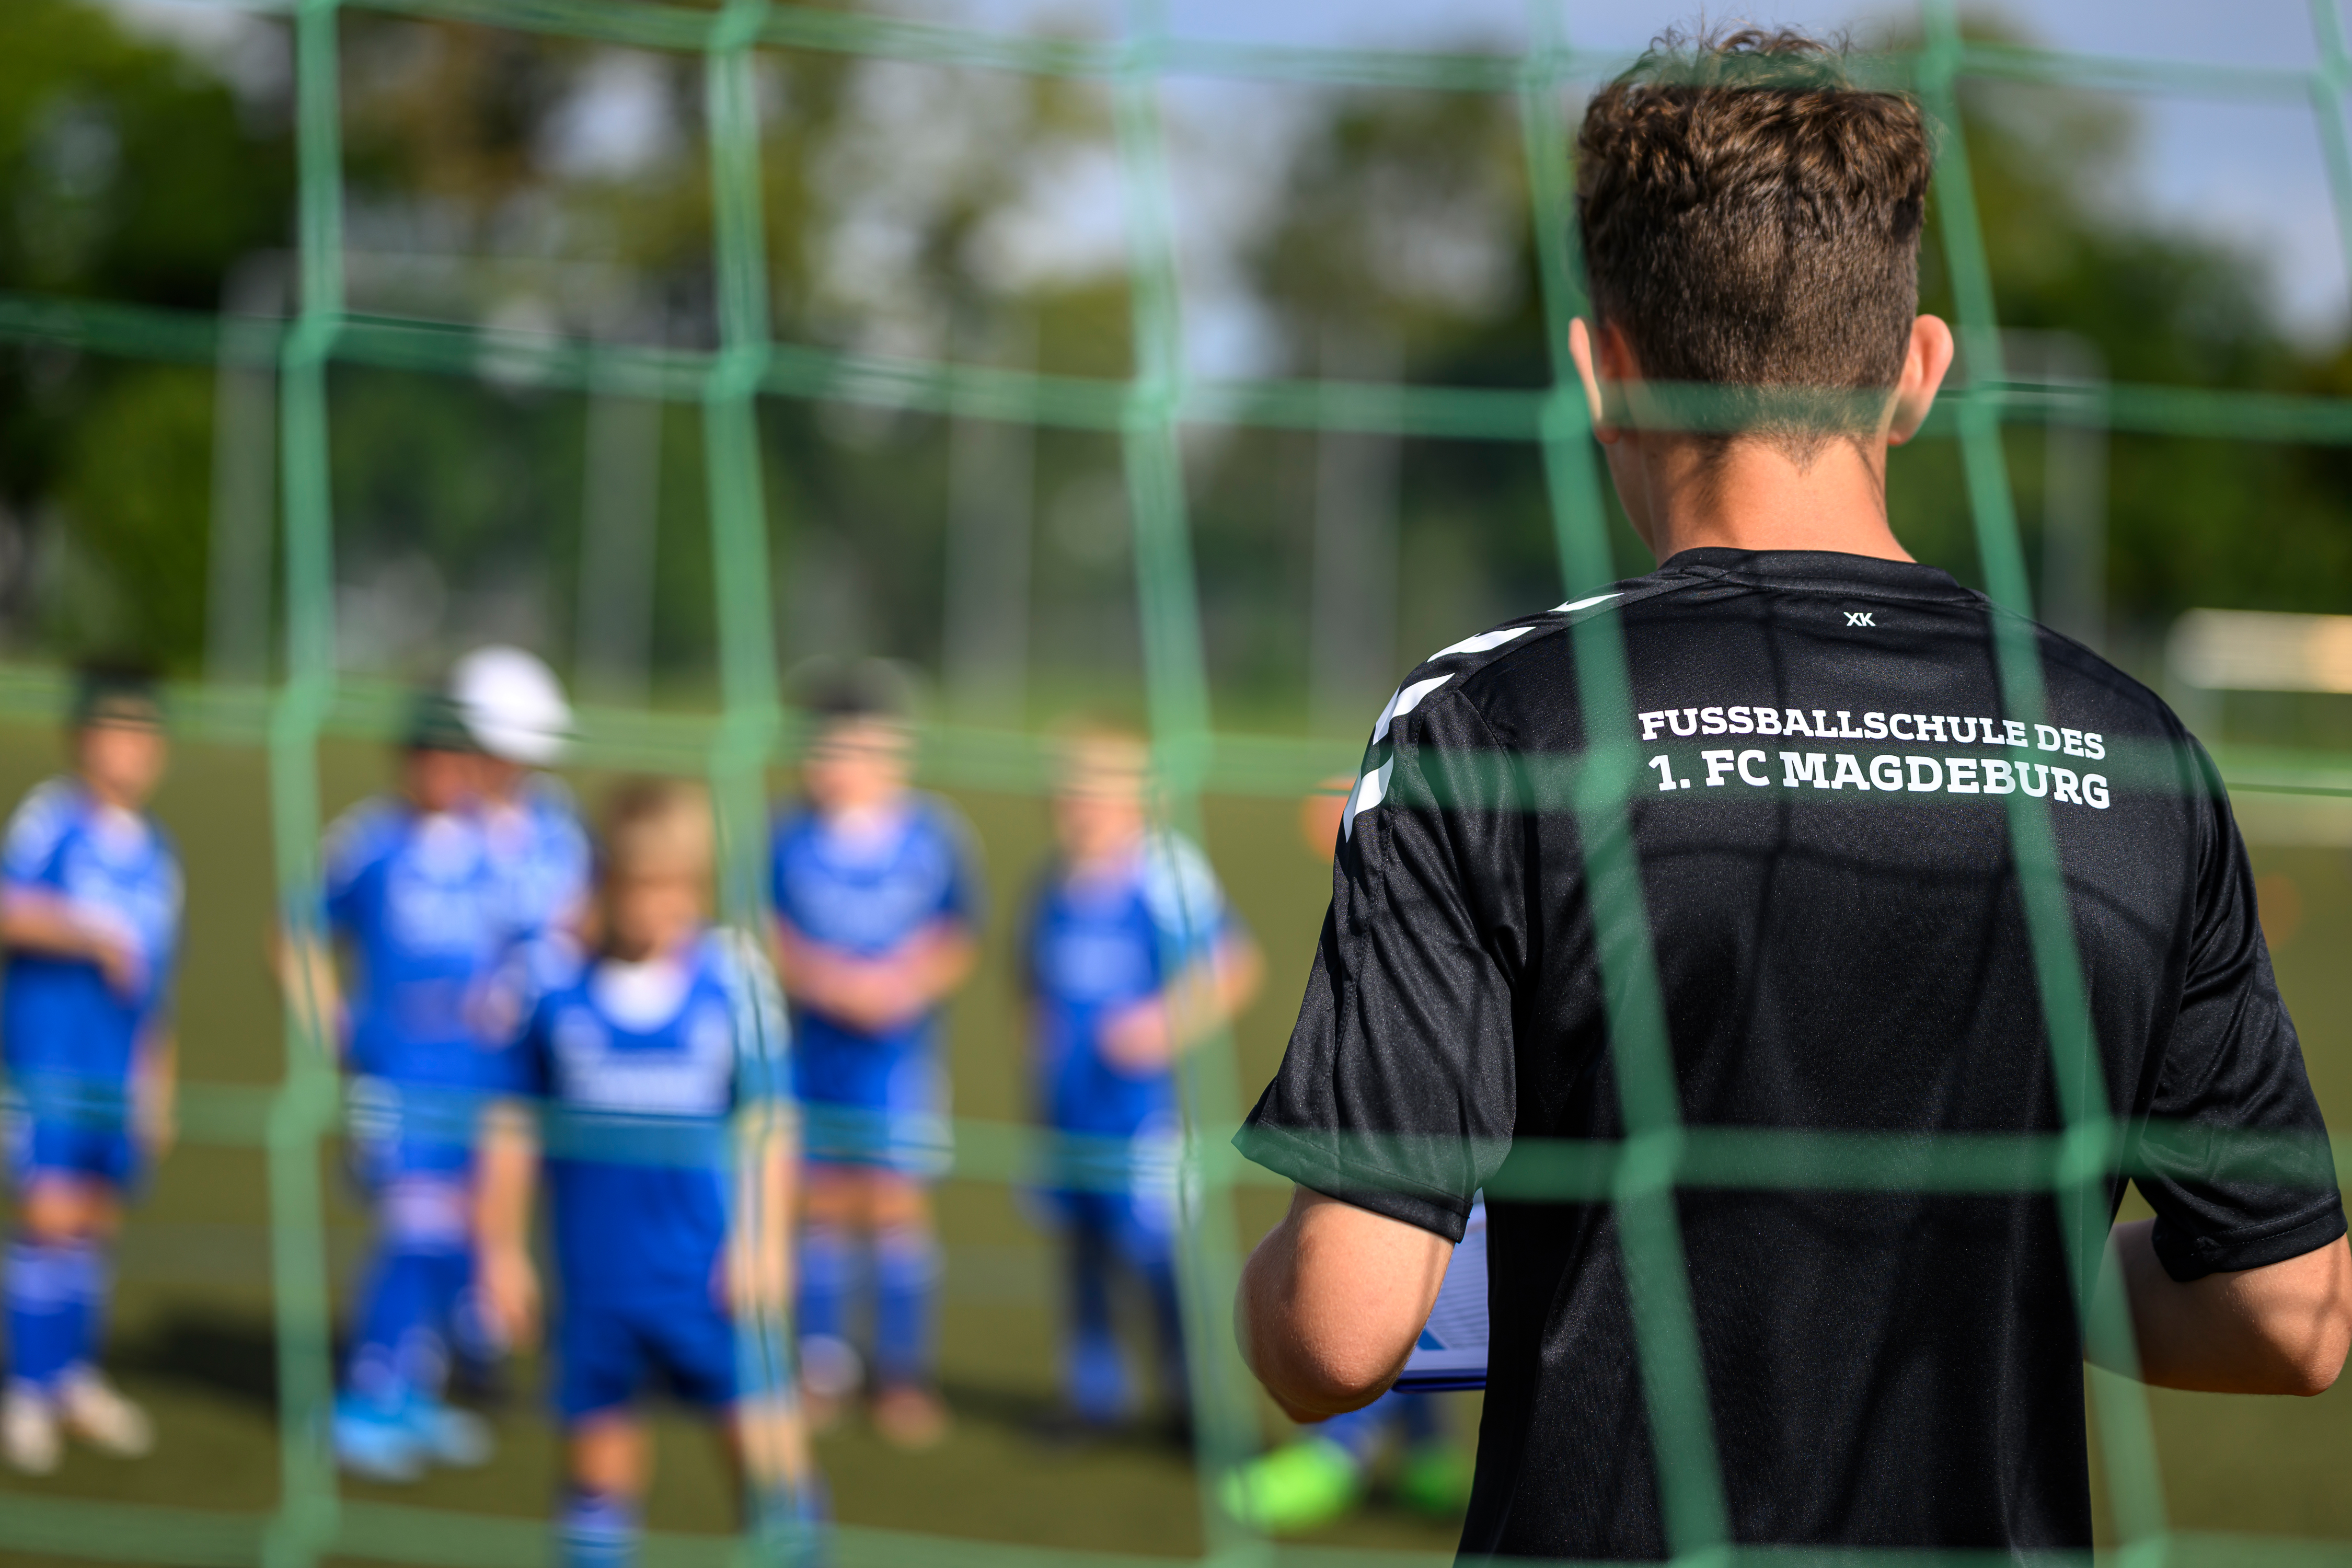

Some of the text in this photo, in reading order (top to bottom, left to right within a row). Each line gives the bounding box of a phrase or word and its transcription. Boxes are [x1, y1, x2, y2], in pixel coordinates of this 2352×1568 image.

[1843, 612, 1876, 627] XK
[1638, 705, 2106, 760] FUSSBALLSCHULE DES
[1647, 748, 2111, 810] 1. FC MAGDEBURG
